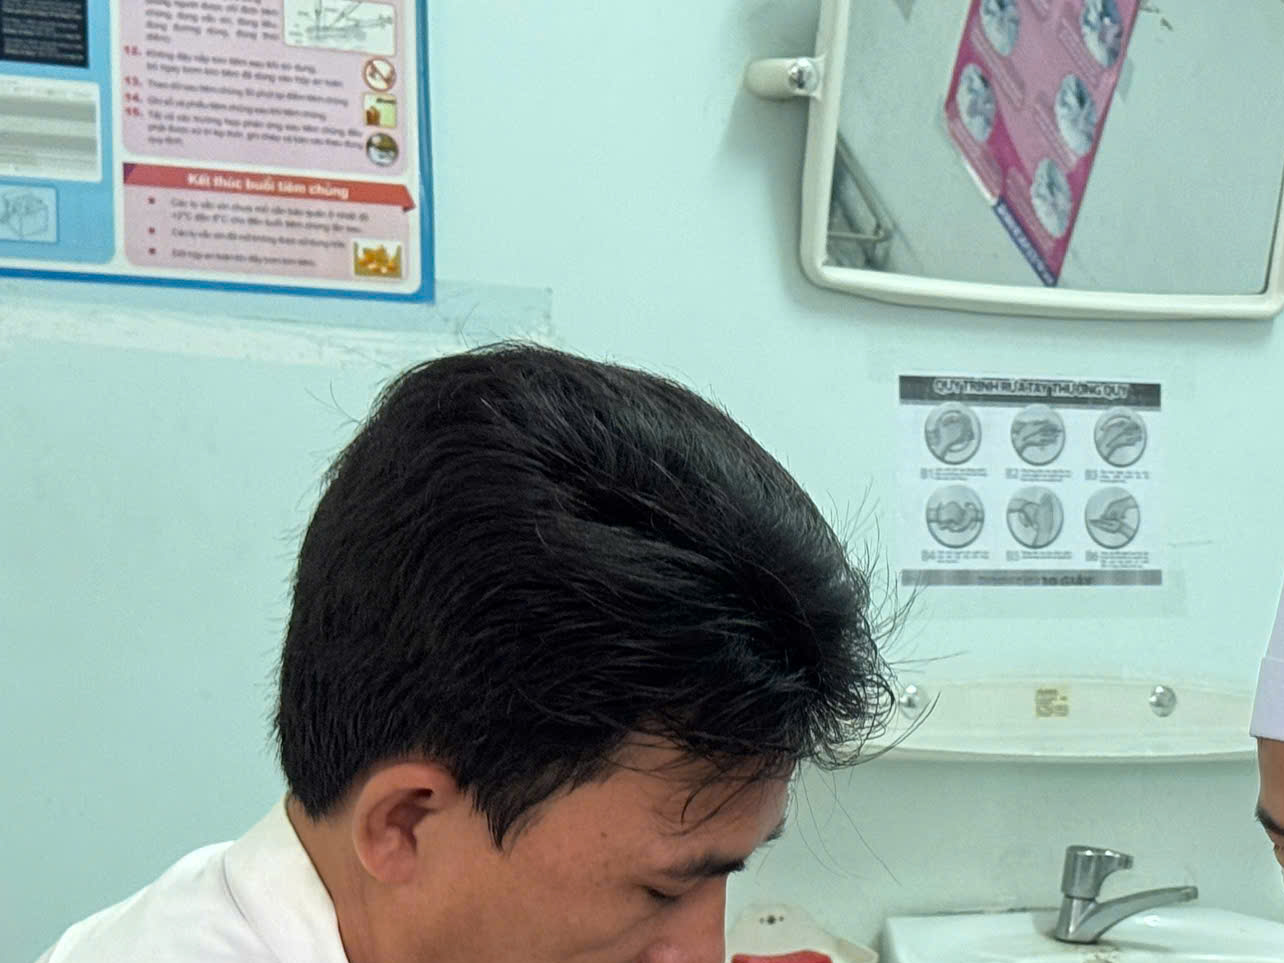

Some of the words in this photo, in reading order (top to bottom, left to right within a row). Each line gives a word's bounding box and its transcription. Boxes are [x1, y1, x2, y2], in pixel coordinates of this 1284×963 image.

[187, 174, 211, 186] Kết
[213, 174, 241, 189] thúc
[278, 179, 306, 194] tiêm
